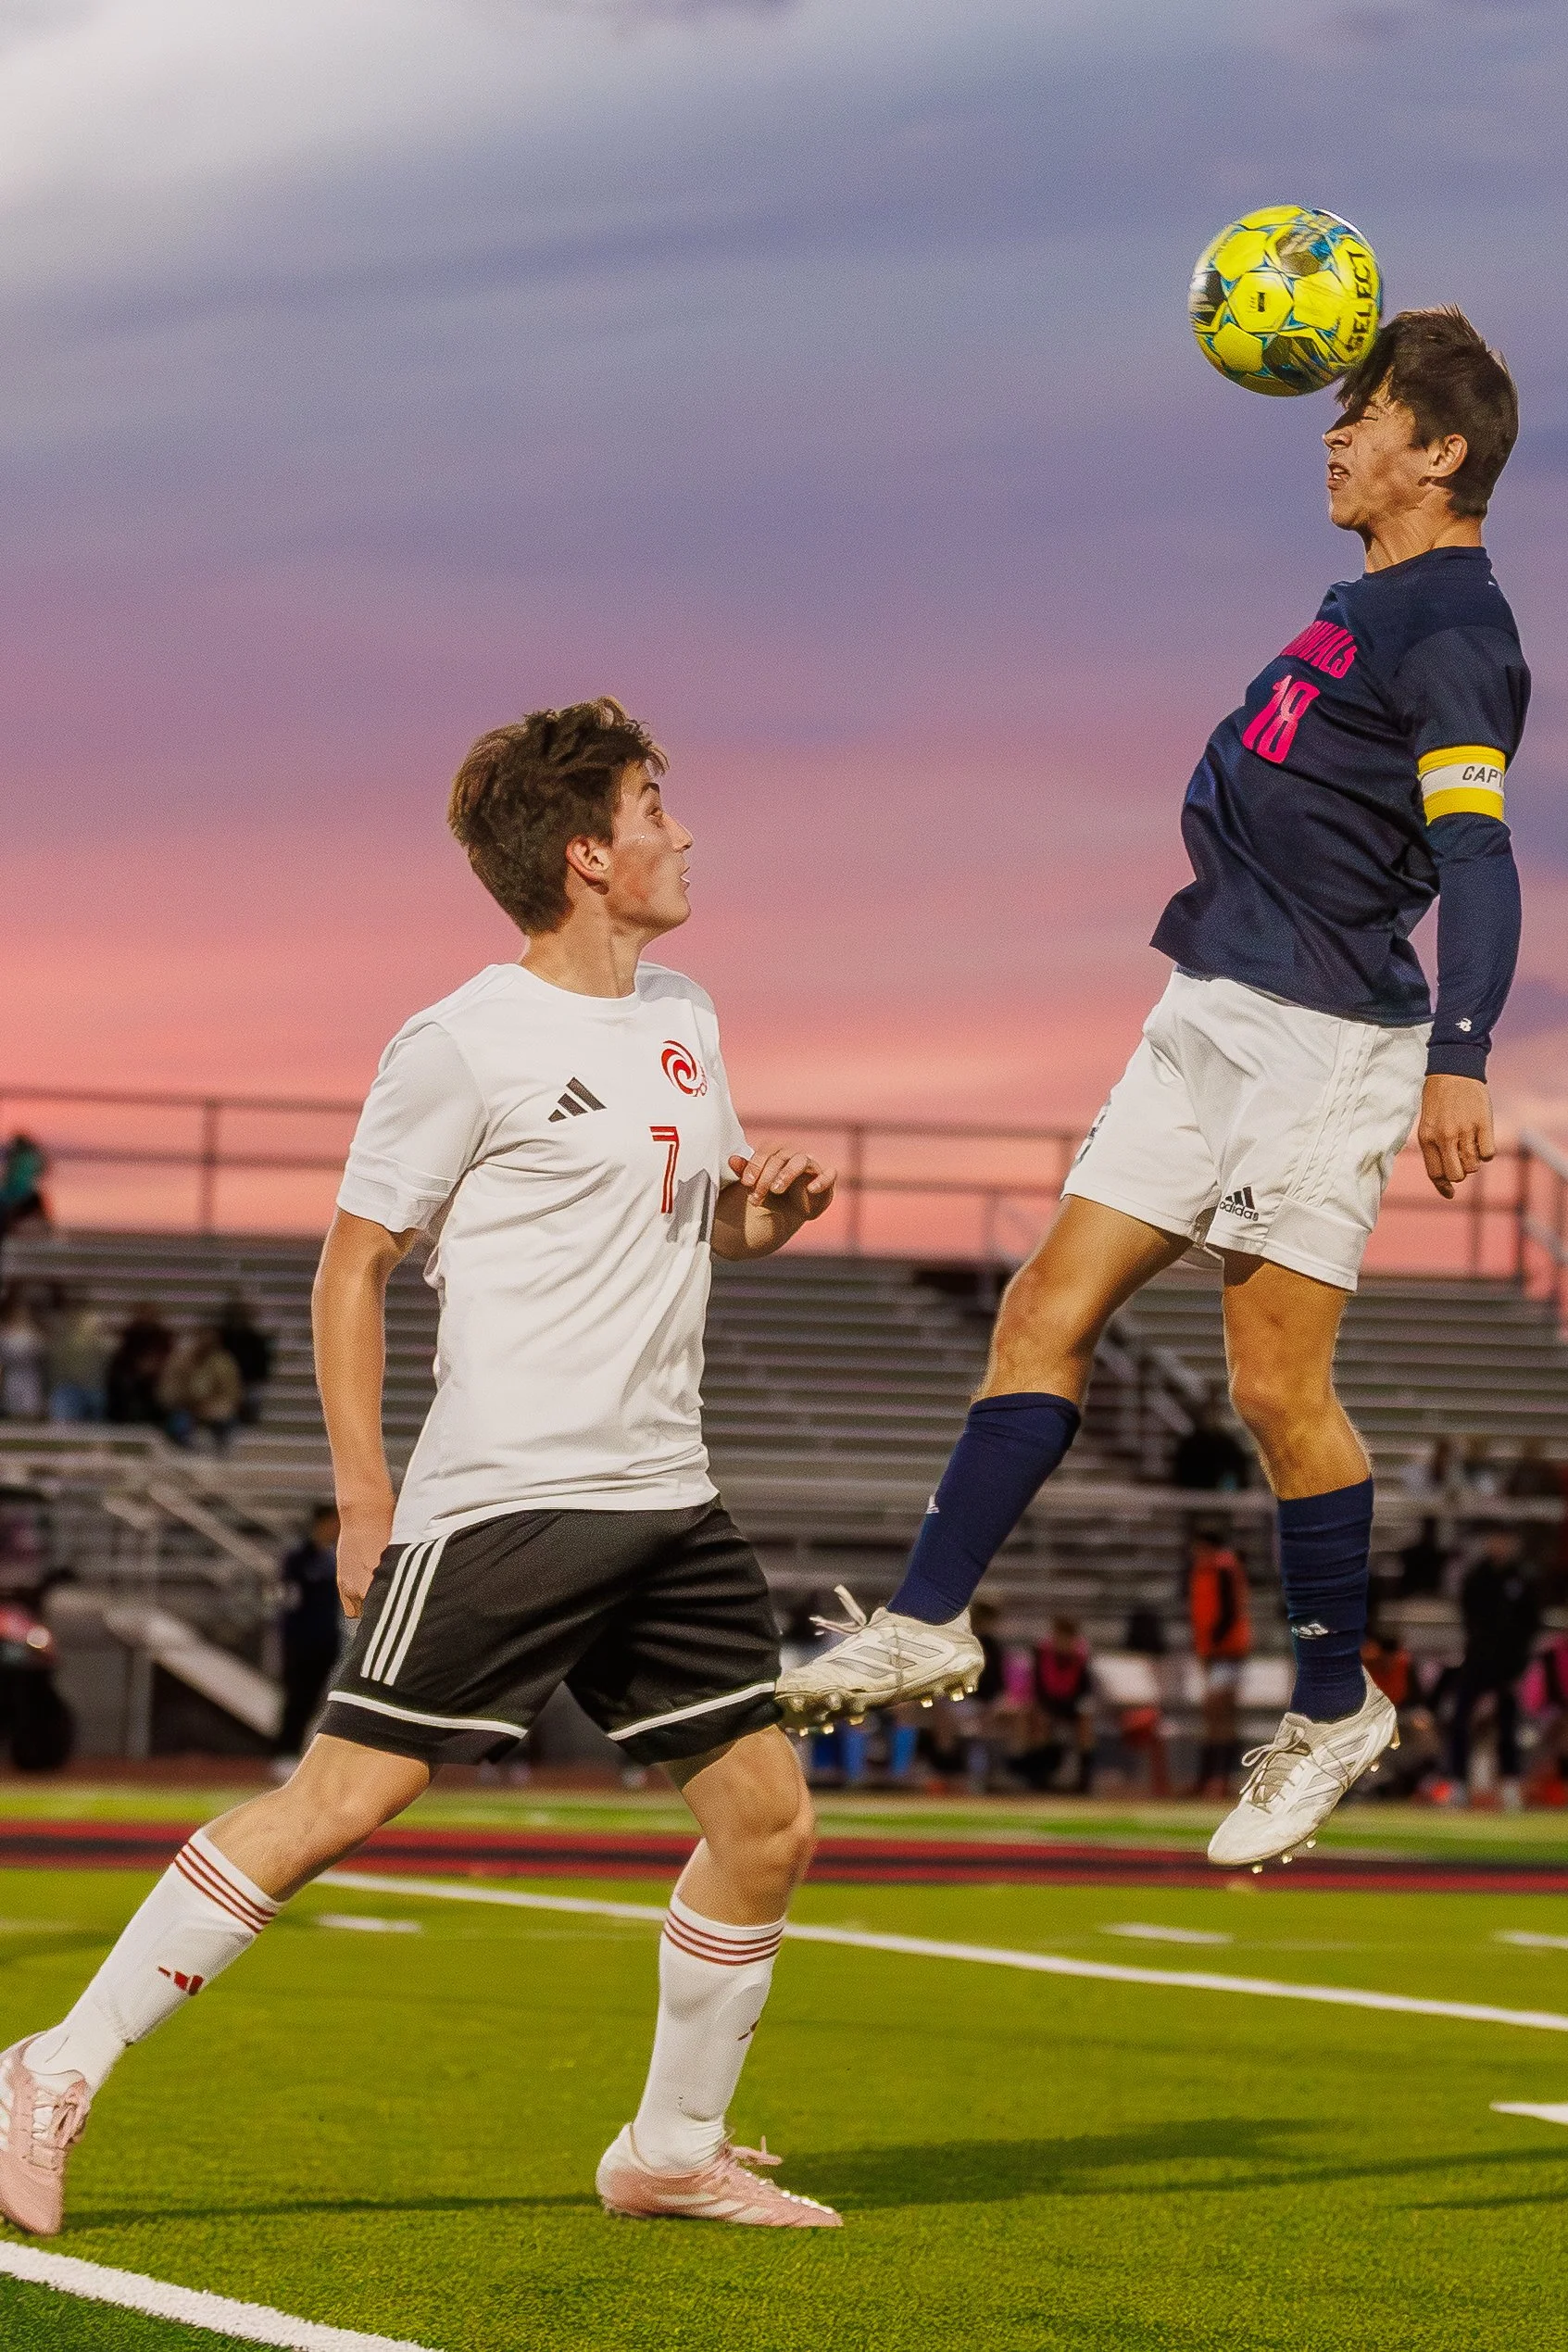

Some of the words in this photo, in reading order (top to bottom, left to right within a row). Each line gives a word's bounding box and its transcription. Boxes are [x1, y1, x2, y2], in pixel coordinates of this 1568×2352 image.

[1345, 250, 1373, 353] SELECT
[1241, 674, 1321, 764] 18
[648, 1126, 680, 1214] 7
[1219, 1201, 1260, 1222] adidas
